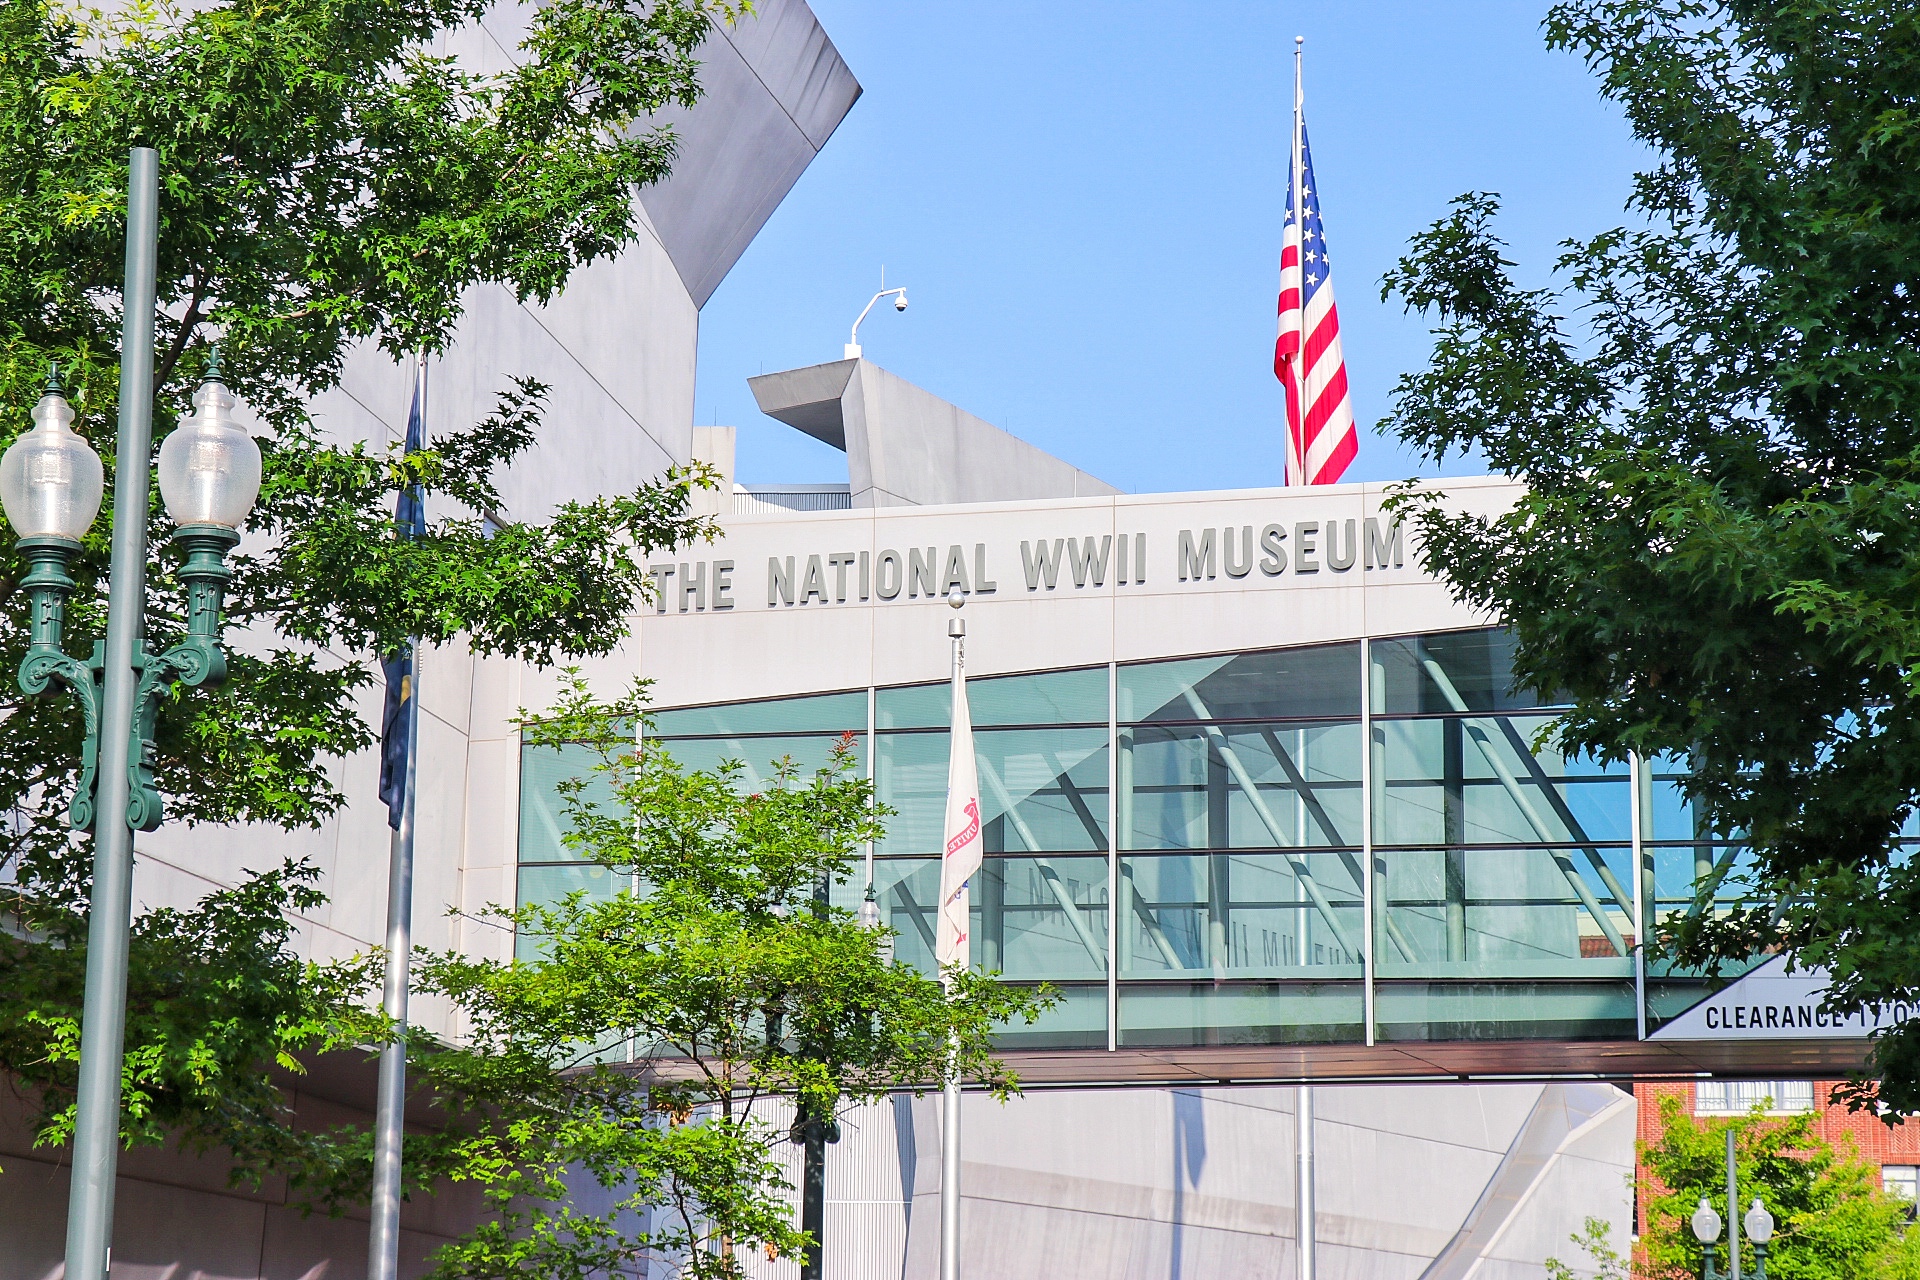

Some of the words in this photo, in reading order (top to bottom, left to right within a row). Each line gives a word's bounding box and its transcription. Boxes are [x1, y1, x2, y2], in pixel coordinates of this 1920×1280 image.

[650, 560, 735, 614] THE
[767, 543, 997, 605] NATIONAL
[1020, 532, 1146, 592] WWII
[1178, 515, 1404, 582] MUSEUM
[1706, 1005, 1844, 1028] CLEARANCE
